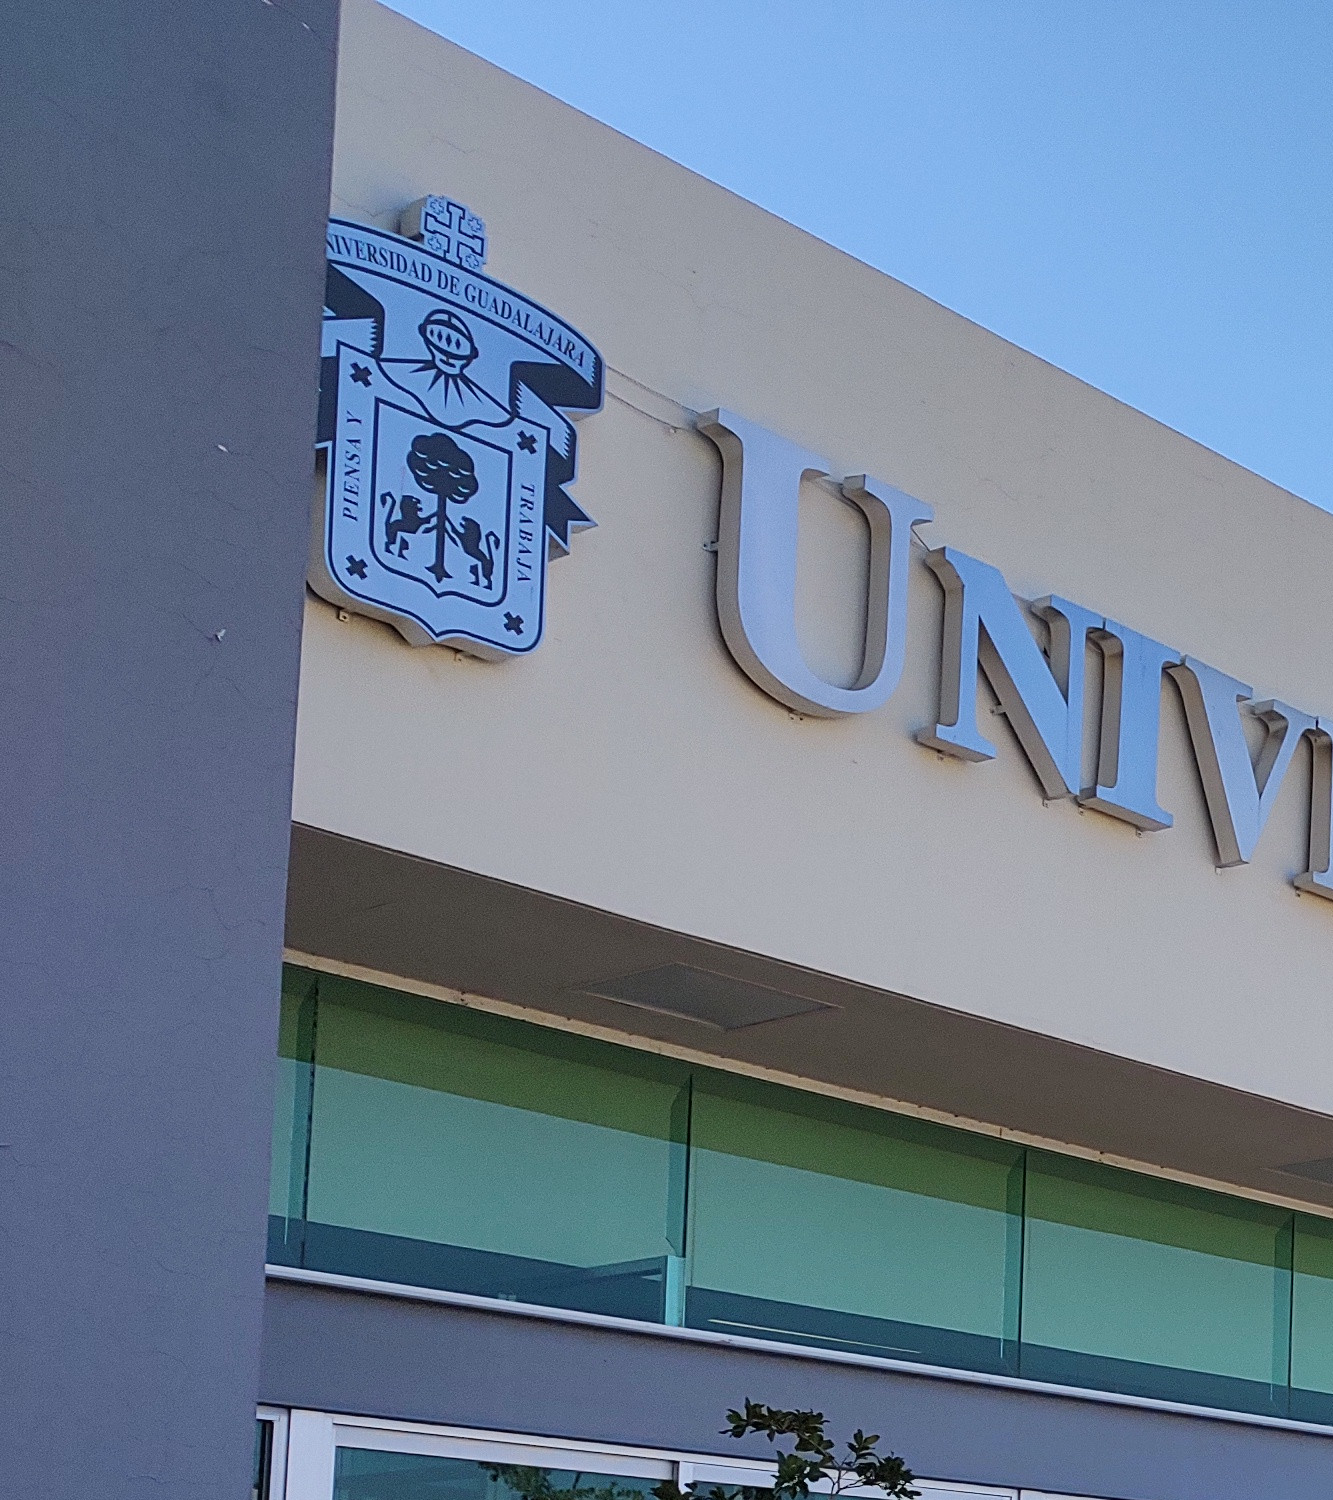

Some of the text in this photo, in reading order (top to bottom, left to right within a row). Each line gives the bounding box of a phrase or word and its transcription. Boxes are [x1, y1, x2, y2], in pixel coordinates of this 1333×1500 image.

[326, 232, 586, 369] NIVERSIDAD DE GUADALAJARA
[342, 410, 364, 523] PIENSA Y
[516, 483, 535, 583] TRABAJA
